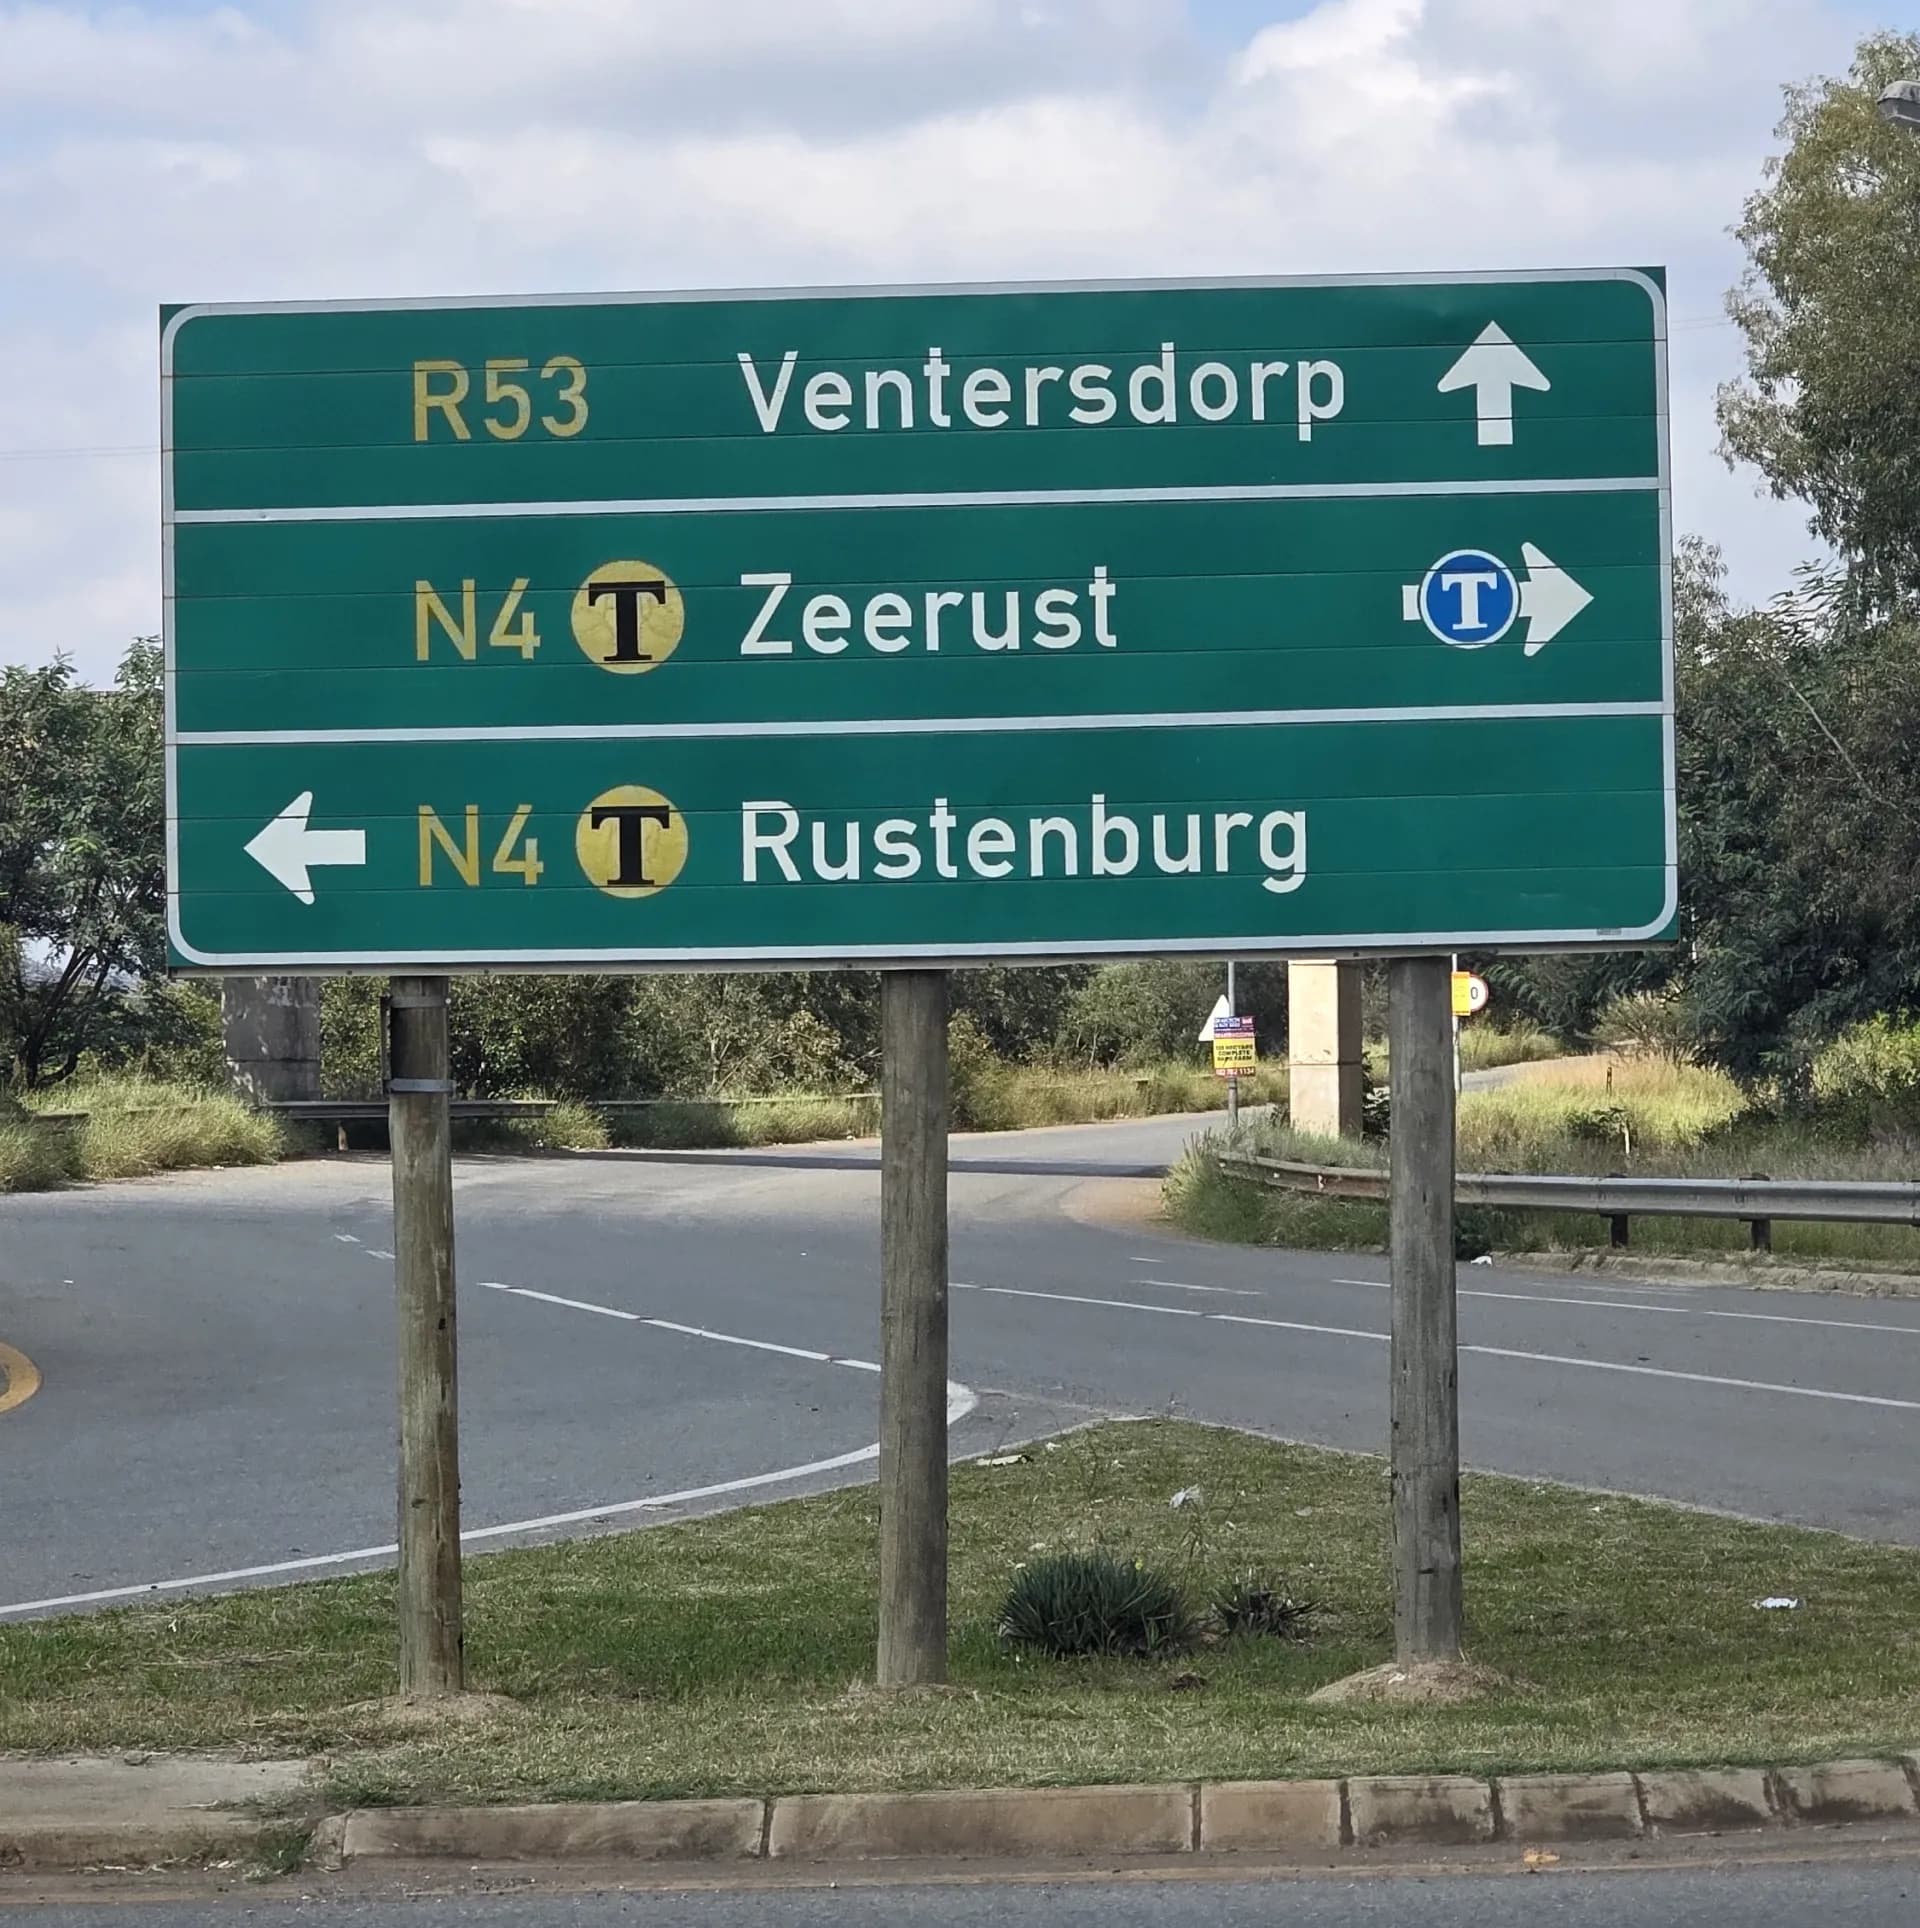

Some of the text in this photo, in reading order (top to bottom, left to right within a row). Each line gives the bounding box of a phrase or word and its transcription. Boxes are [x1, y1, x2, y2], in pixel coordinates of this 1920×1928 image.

[412, 341, 1346, 442] R53 Ventersdorp
[415, 566, 1498, 663] N4 T Zeerust T
[417, 793, 1308, 893] N4 T Rustenburg
[1470, 986, 1479, 1000] 0
